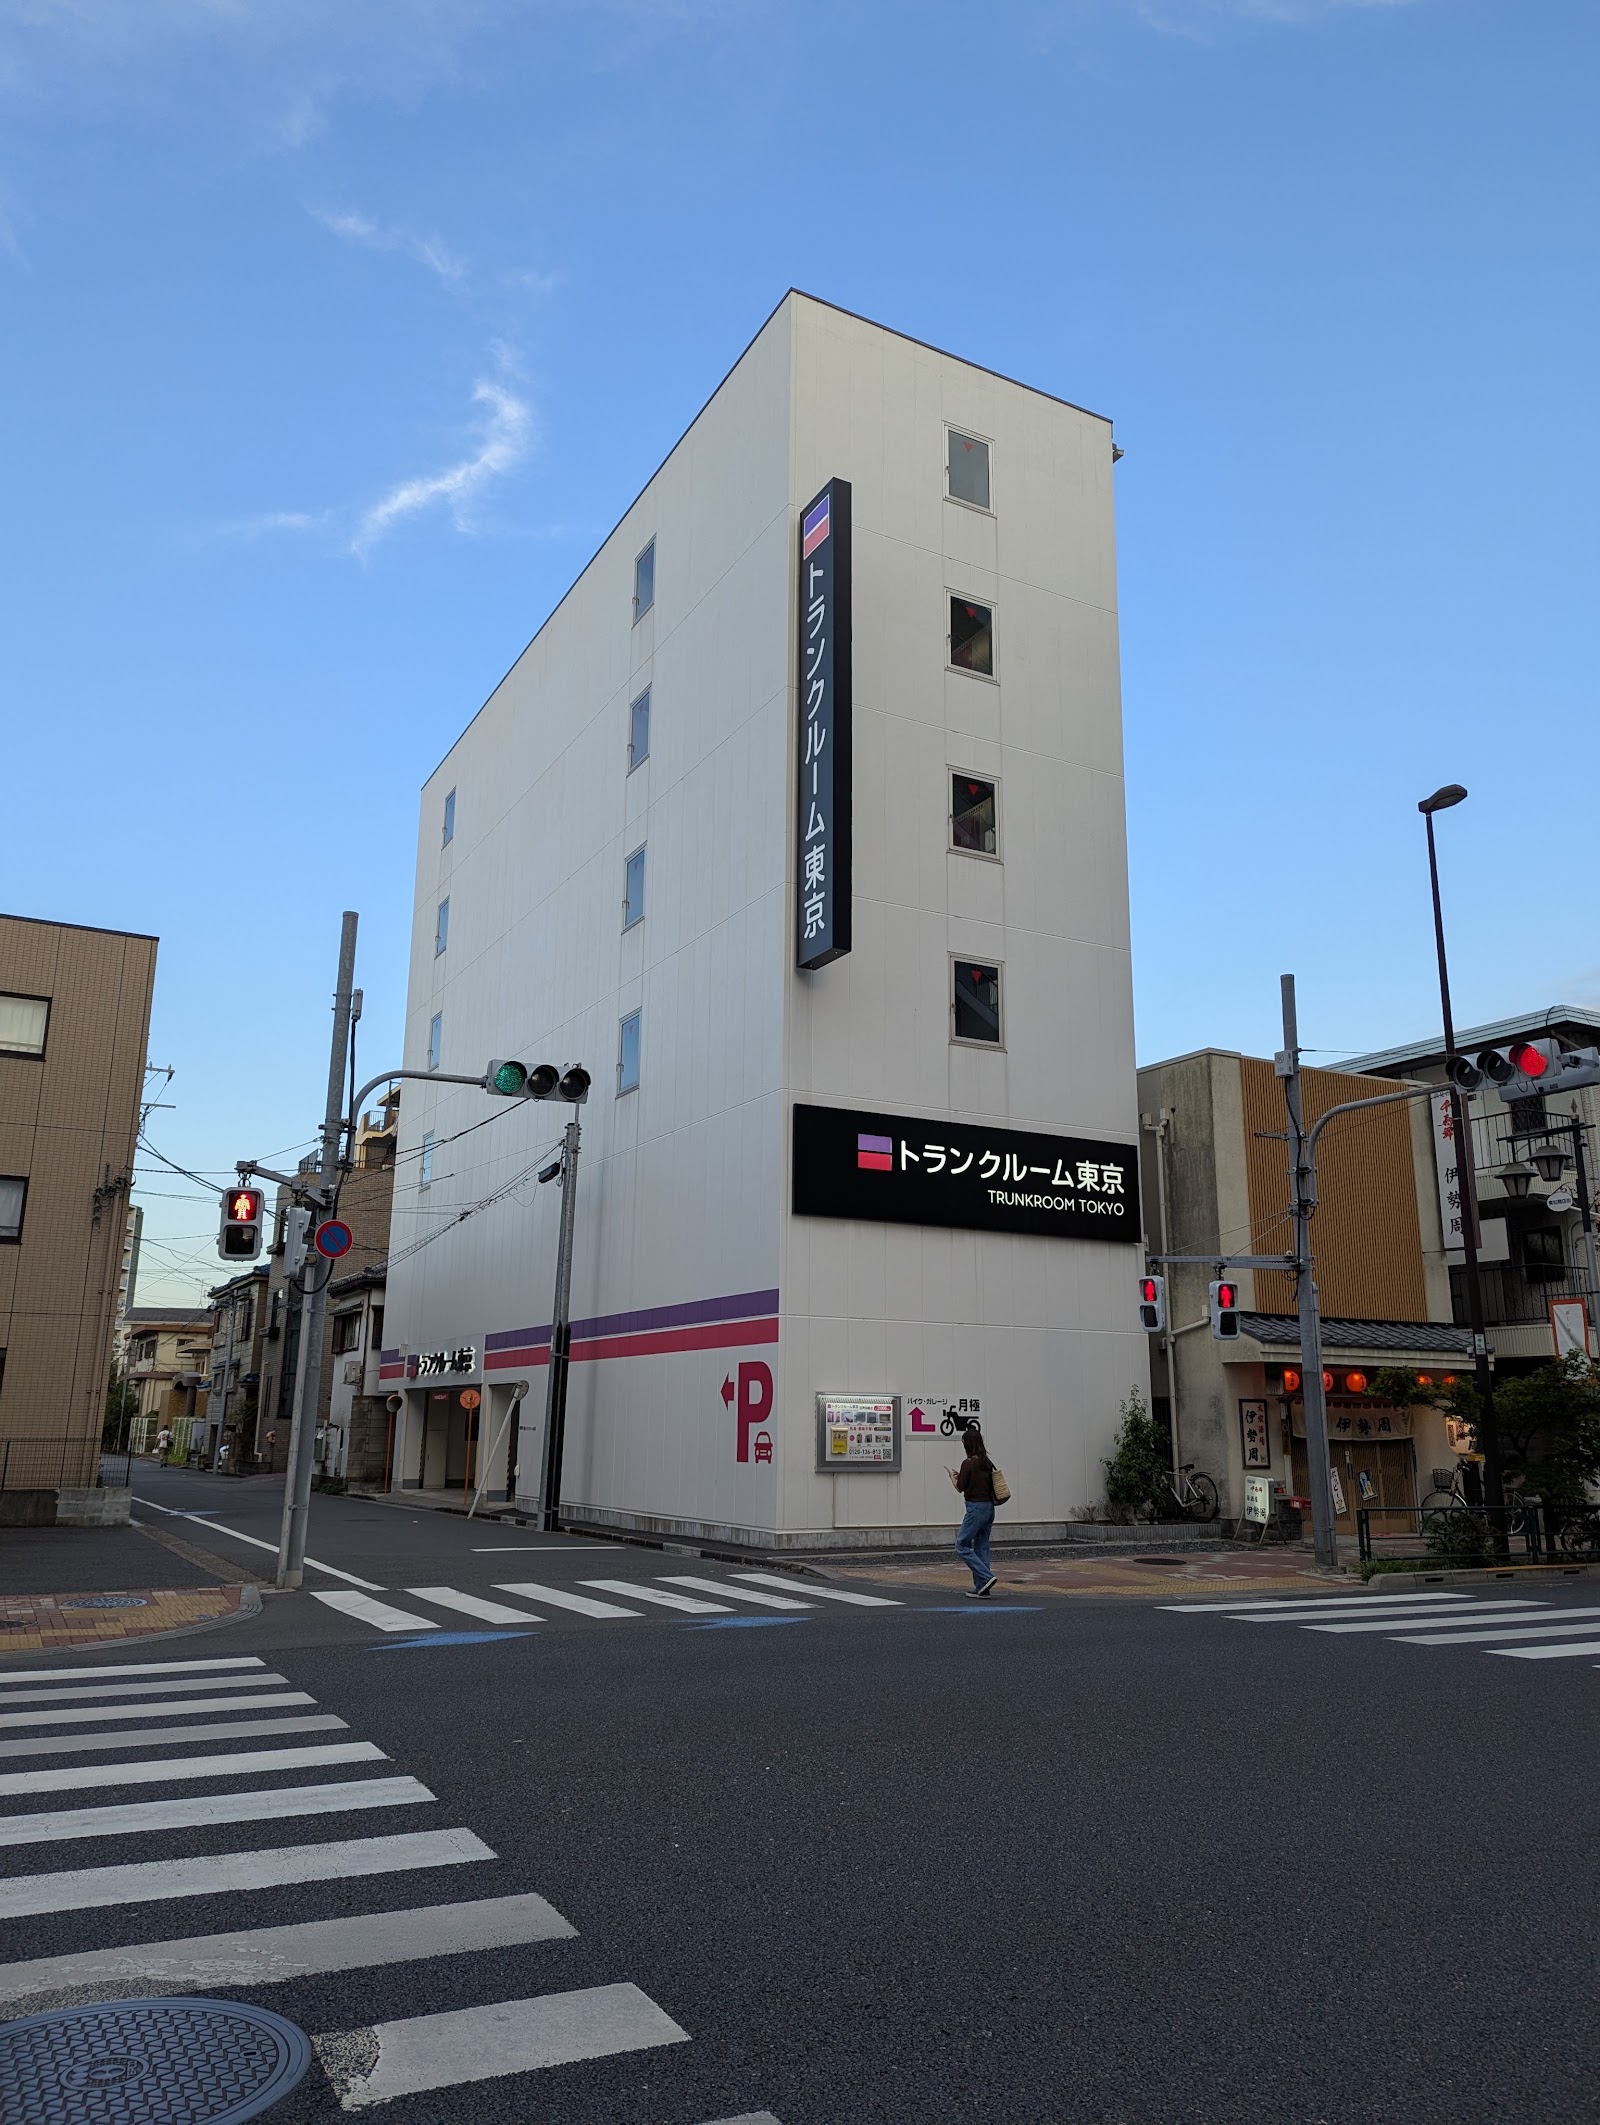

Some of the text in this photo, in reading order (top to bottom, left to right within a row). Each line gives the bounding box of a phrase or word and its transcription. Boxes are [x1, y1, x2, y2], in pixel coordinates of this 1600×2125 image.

[804, 562, 826, 939] トランクルーム東京
[900, 1139, 1125, 1194] トランクルーム東京
[987, 1189, 1125, 1216] TRUNKROOM TOKYO
[1444, 1167, 1463, 1236] 伊勢周
[736, 1361, 774, 1463] P
[907, 1397, 948, 1406] バイク・ガレージ
[958, 1398, 981, 1412] 月極
[1245, 1410, 1258, 1462] 伊勢周
[1336, 1416, 1392, 1435] 伊勢周
[1246, 1505, 1266, 1519] 伊勢周
